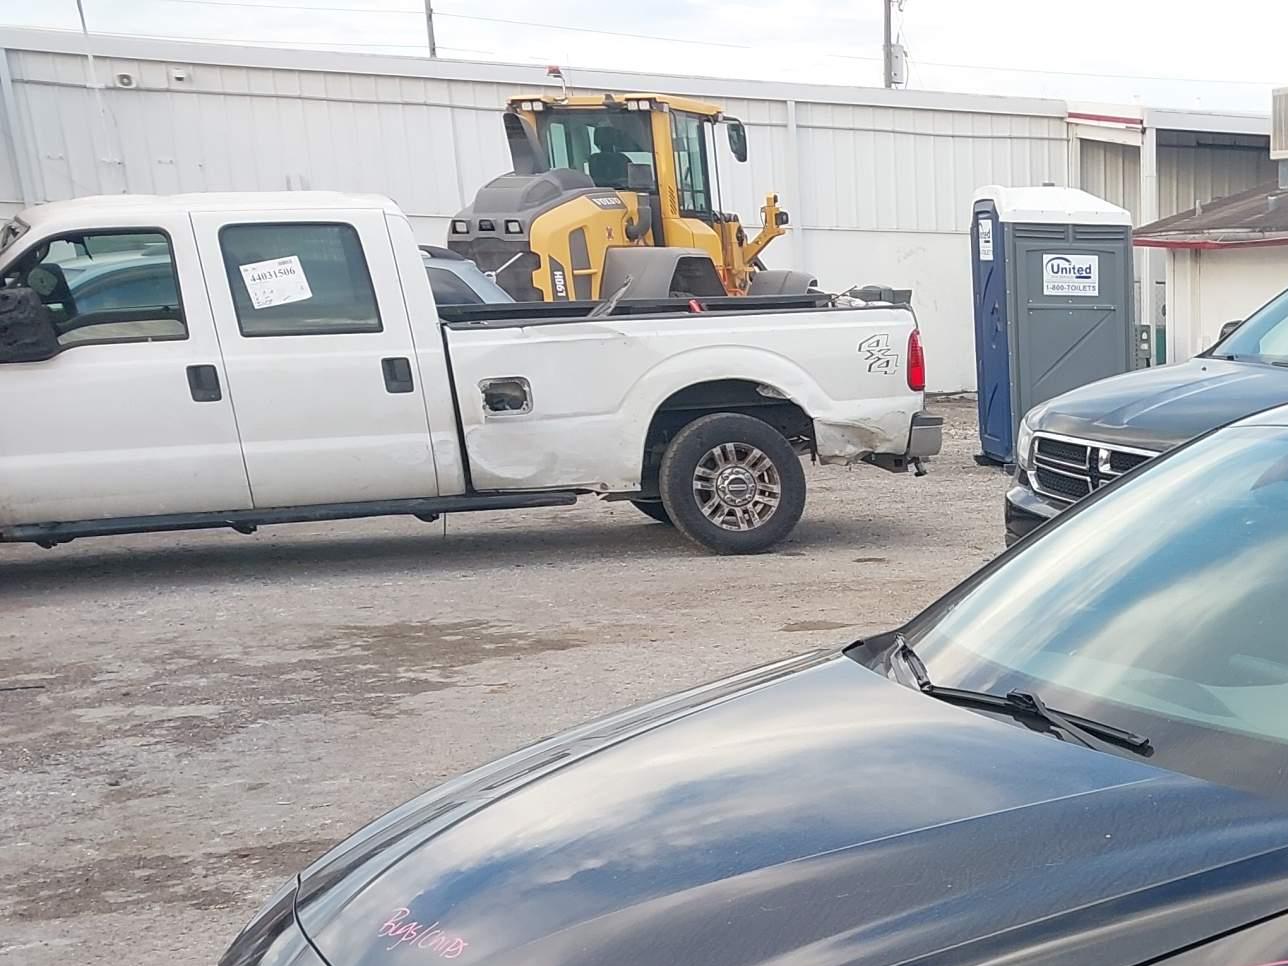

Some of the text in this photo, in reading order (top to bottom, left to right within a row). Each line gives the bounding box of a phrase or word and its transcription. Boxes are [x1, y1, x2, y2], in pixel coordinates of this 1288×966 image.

[250, 267, 296, 282] 44031506
[1051, 263, 1092, 275] United
[553, 271, 567, 297] L90H
[1046, 284, 1097, 292] 1-800-TOILETS
